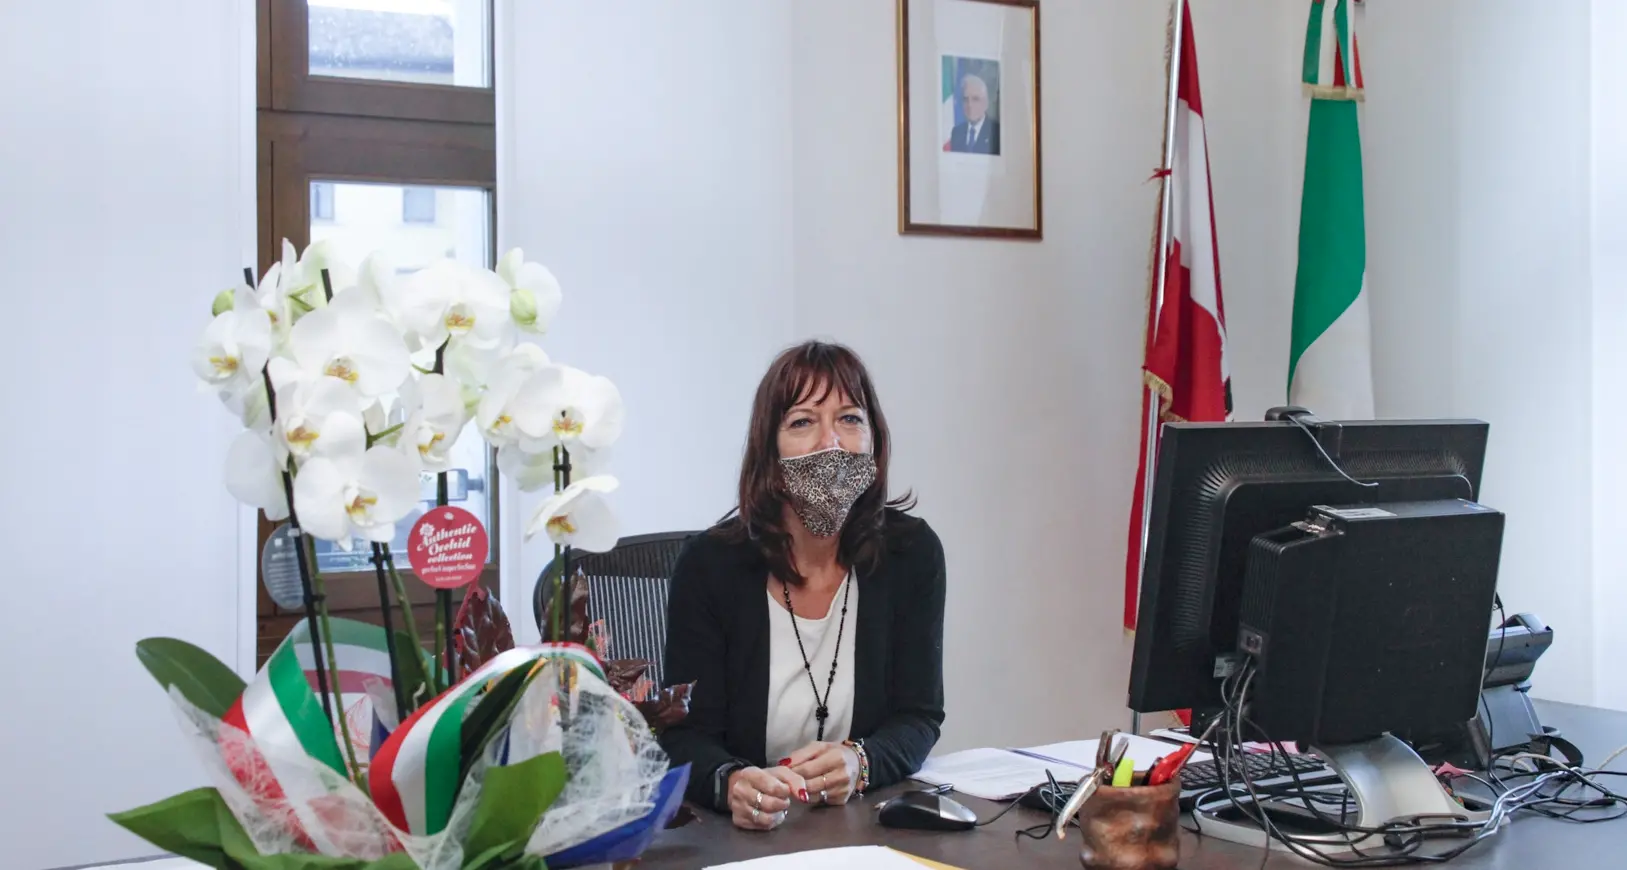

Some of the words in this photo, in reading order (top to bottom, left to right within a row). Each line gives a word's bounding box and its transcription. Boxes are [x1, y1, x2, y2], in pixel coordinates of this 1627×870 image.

[416, 523, 477, 552] Authentic
[428, 536, 472, 556] Orchid
[427, 552, 473, 564] collection
